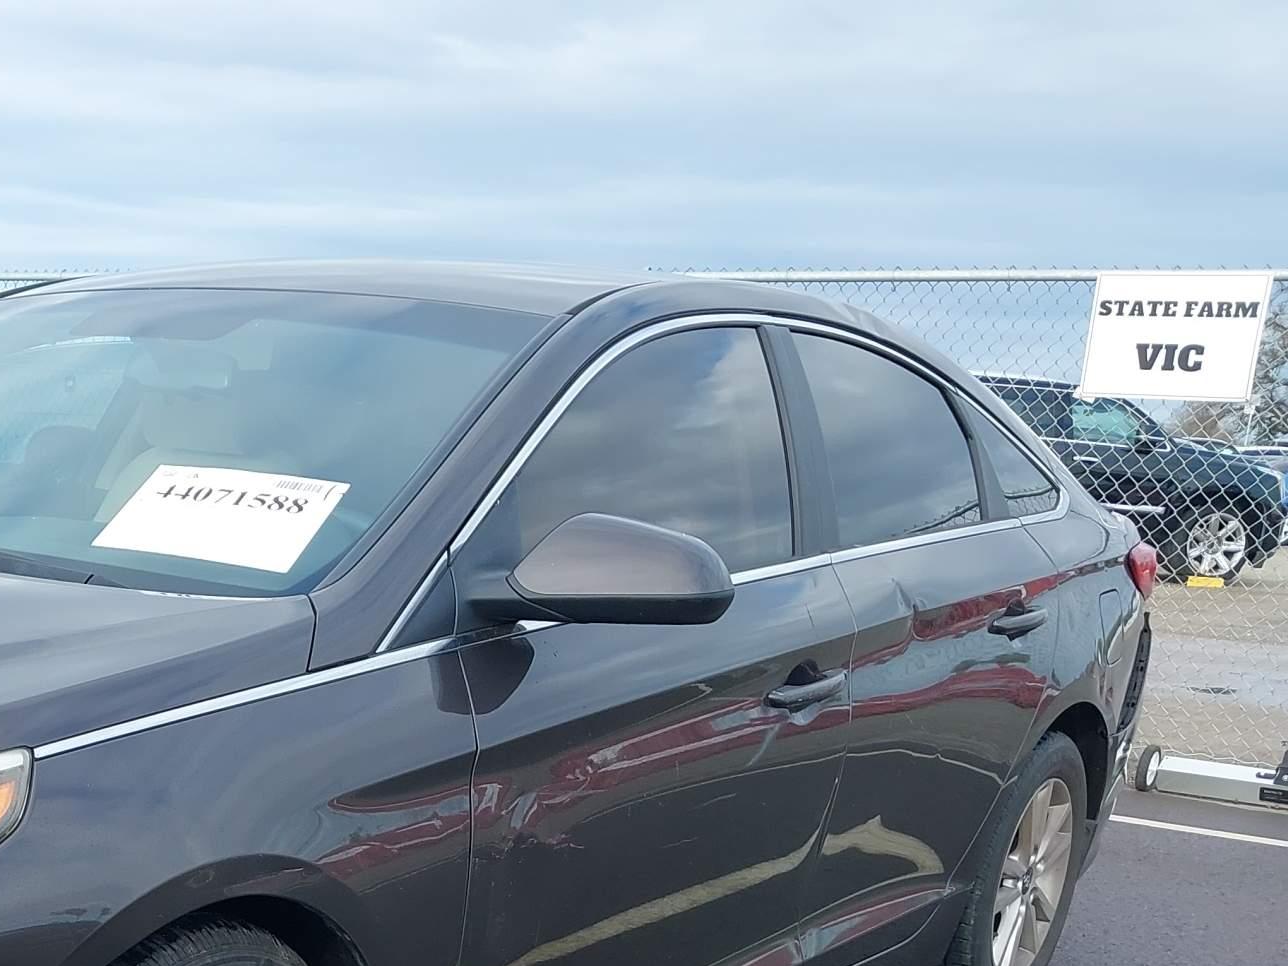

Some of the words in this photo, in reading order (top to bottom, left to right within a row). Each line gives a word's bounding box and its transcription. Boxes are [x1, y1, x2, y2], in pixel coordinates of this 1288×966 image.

[1098, 299, 1179, 317] STATE
[1183, 301, 1261, 319] FARM
[1135, 343, 1205, 372] VIC
[156, 484, 309, 515] 44071588
